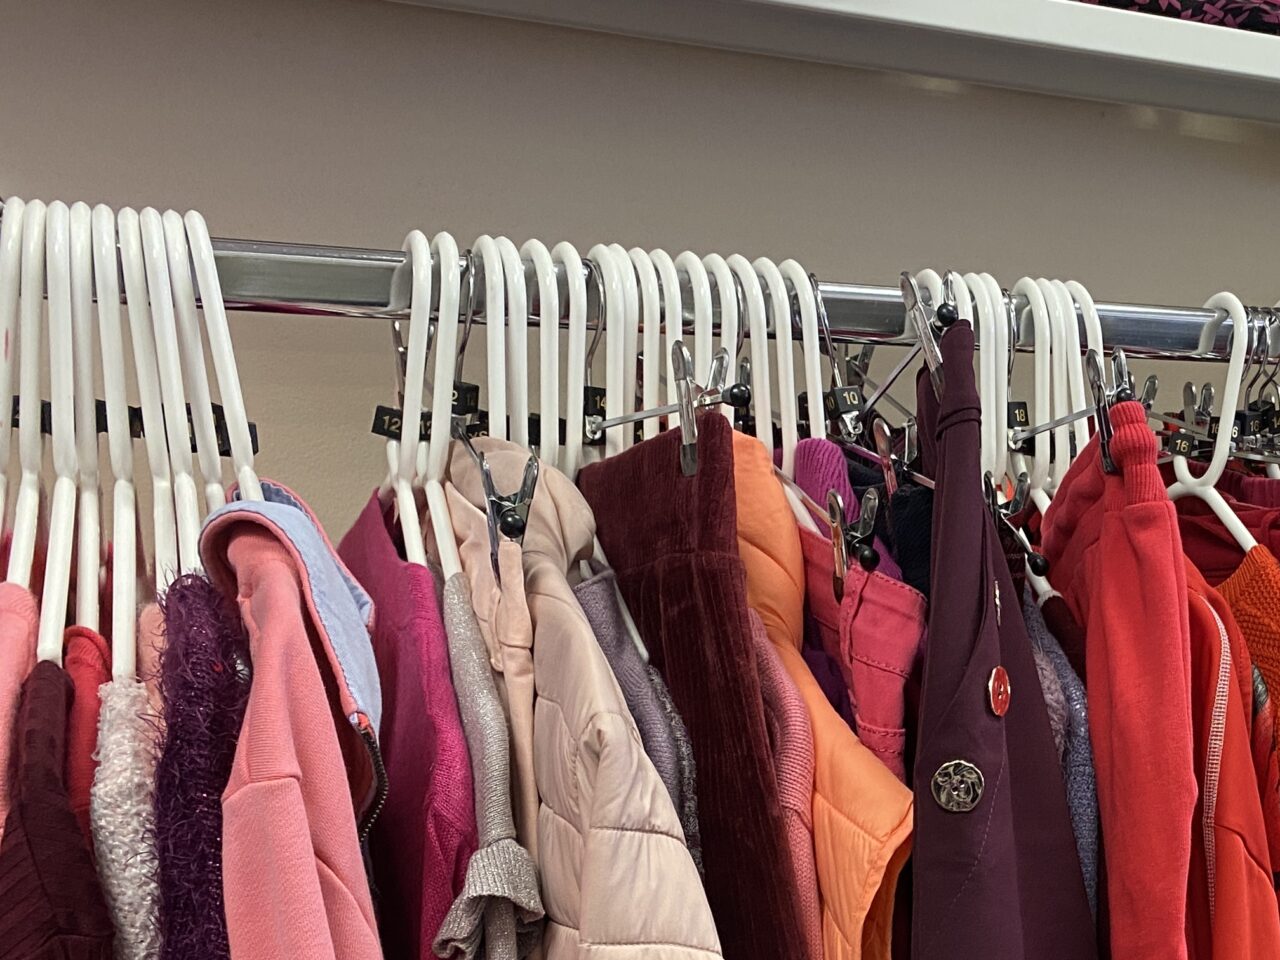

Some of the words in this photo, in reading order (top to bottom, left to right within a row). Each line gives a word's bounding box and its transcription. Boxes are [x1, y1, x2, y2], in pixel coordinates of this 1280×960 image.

[843, 390, 859, 405] 10
[1014, 408, 1026, 422] 18
[383, 415, 401, 433] 12
[1231, 425, 1239, 439] 6
[1175, 439, 1190, 453] 16
